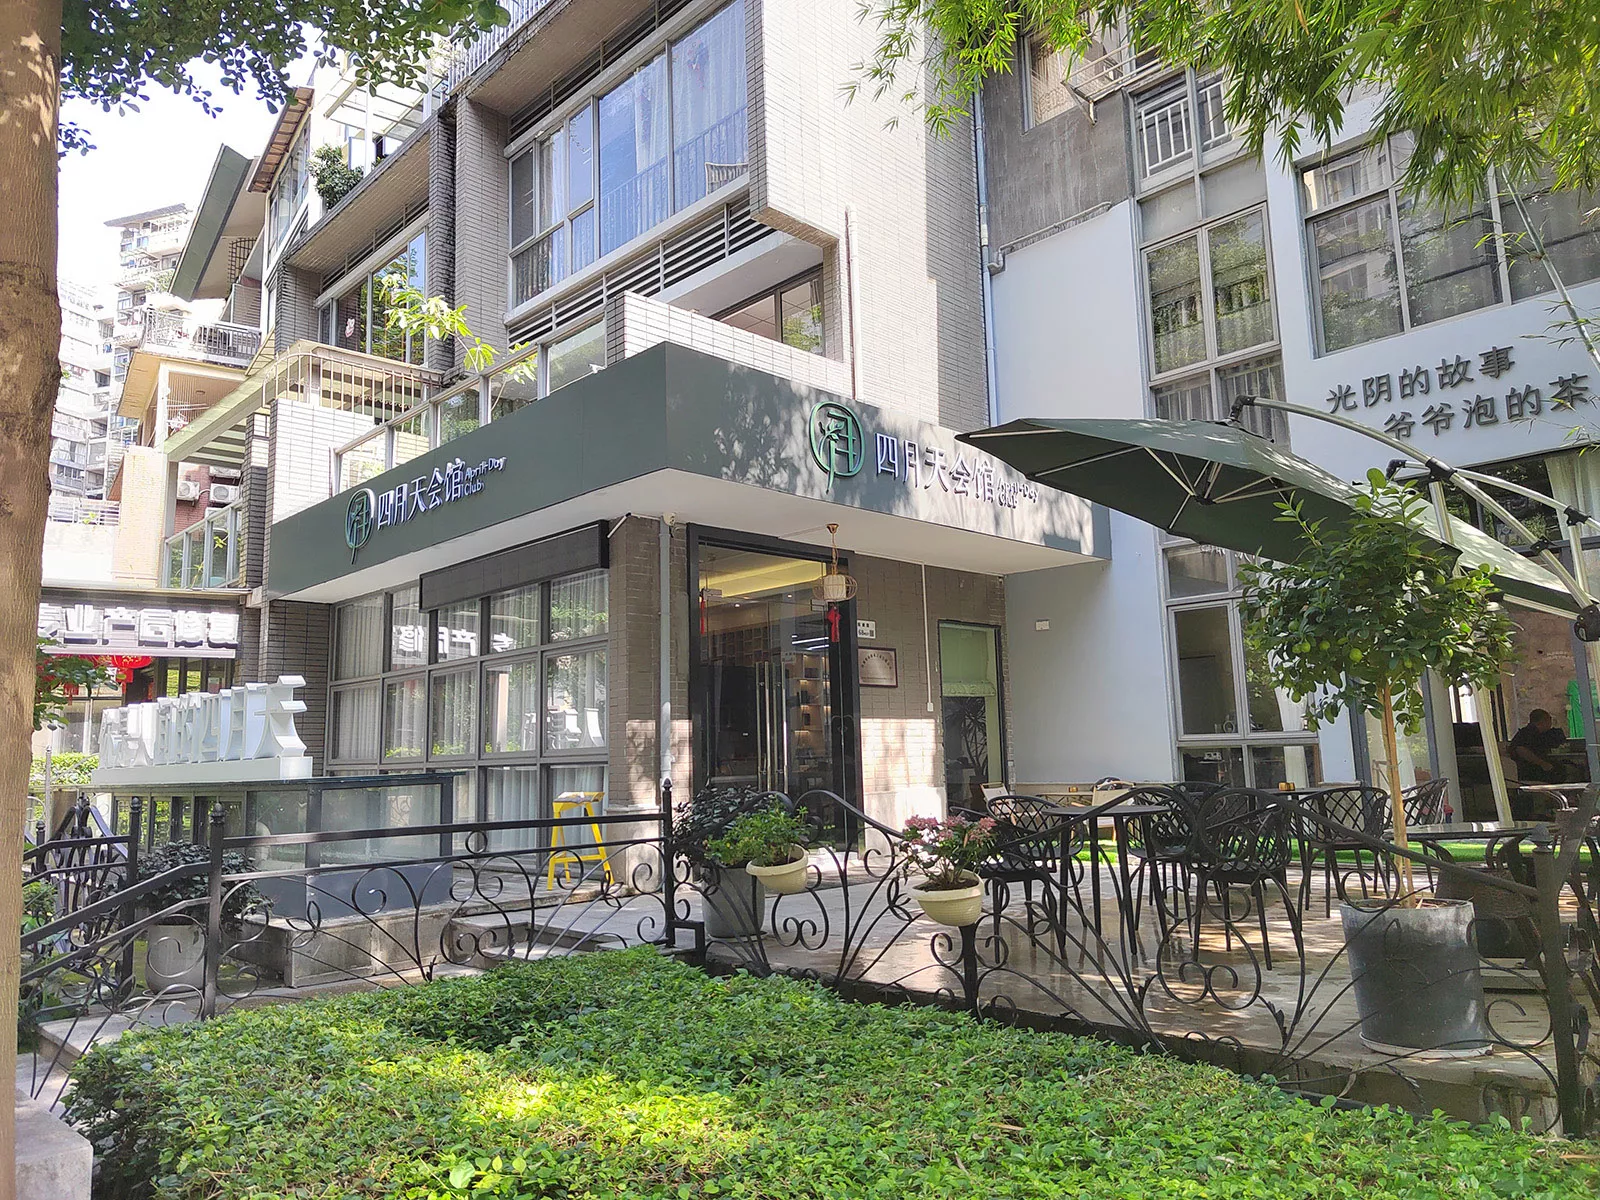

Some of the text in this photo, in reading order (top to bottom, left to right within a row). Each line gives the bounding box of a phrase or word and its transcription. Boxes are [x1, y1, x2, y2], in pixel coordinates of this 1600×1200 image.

[1326, 346, 1515, 414] 光阴的故事
[1383, 373, 1588, 440] 爷爷泡的茶
[378, 457, 465, 530] 四月天会馆
[464, 479, 485, 497] Club
[875, 432, 995, 503] 四月天会馆
